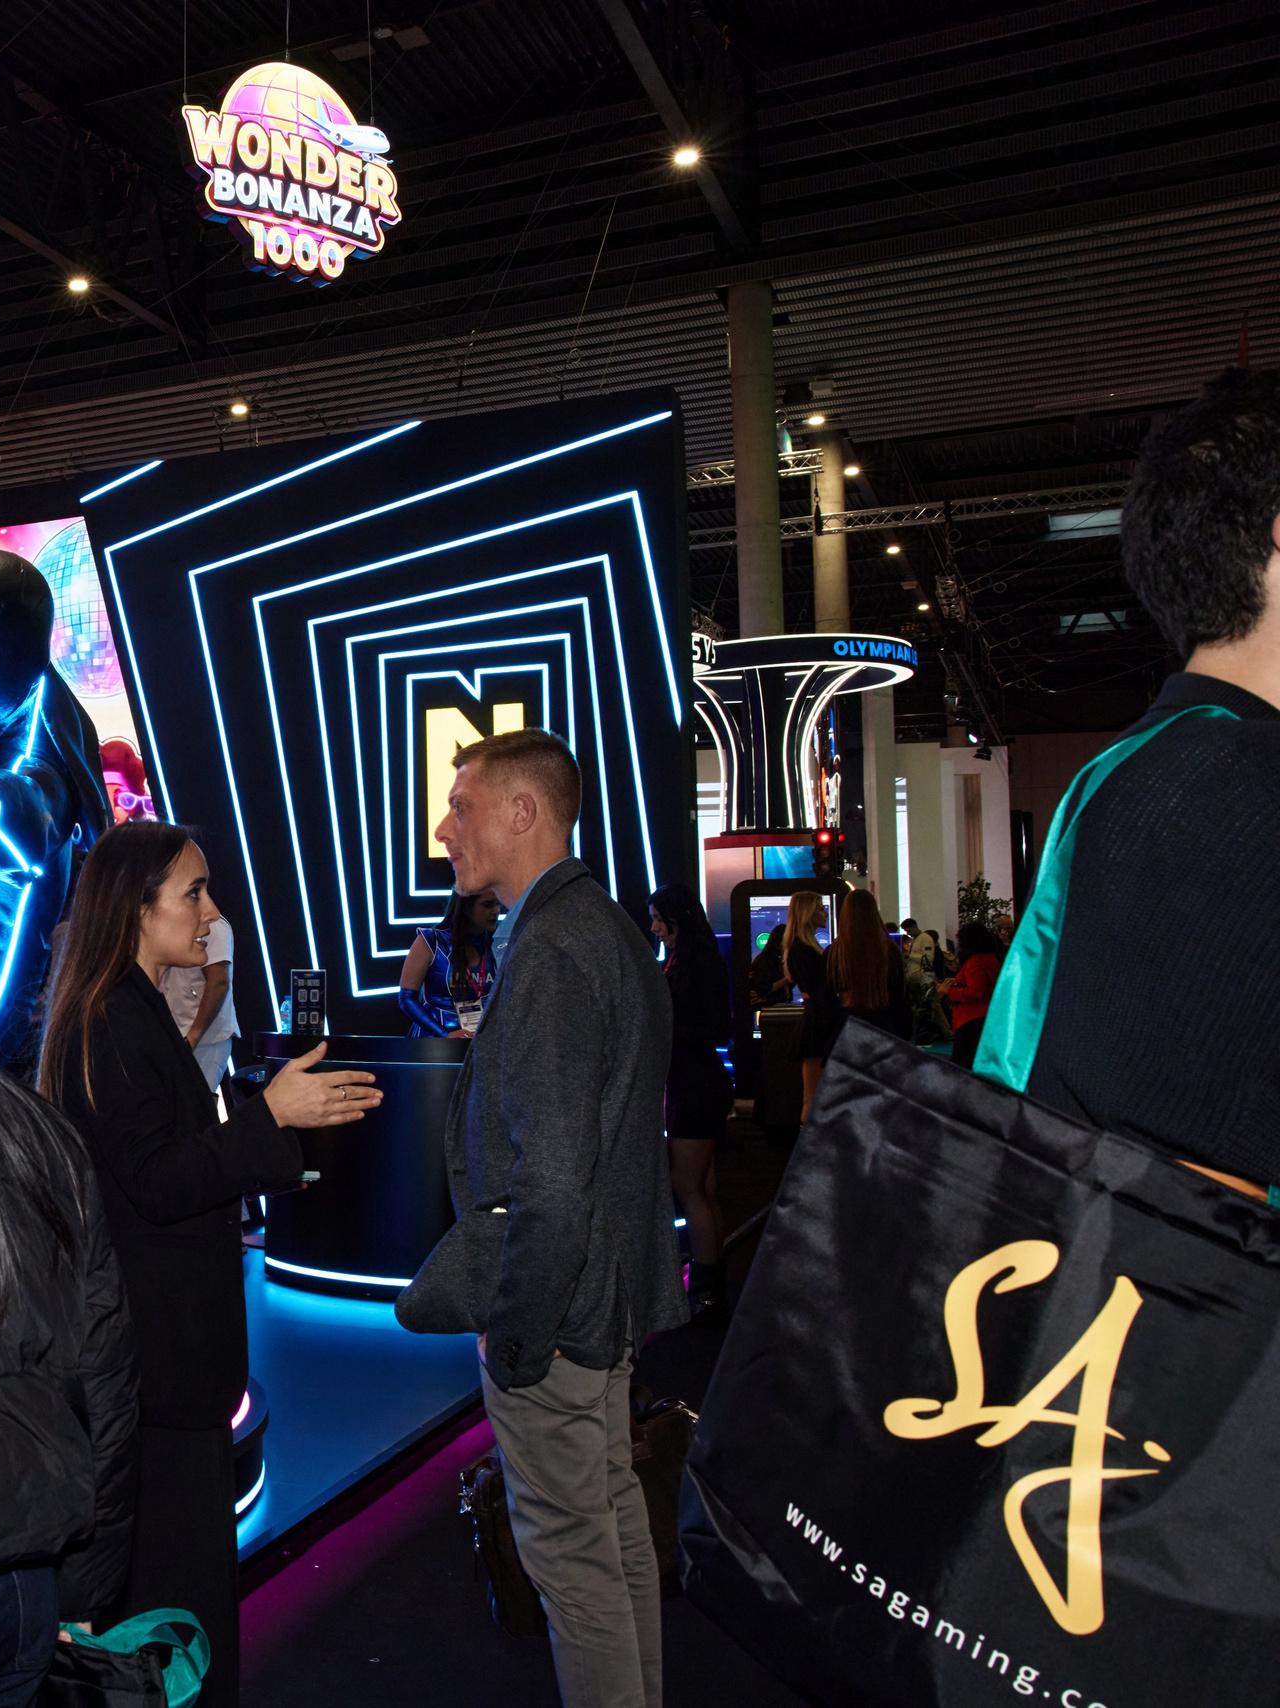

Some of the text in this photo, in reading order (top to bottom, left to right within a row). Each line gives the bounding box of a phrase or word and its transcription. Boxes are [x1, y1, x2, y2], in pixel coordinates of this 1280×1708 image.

[185, 108, 399, 220] WONDER
[213, 167, 378, 241] BONANZA
[248, 220, 345, 279] 1000
[833, 640, 911, 662] OLYMPIAN
